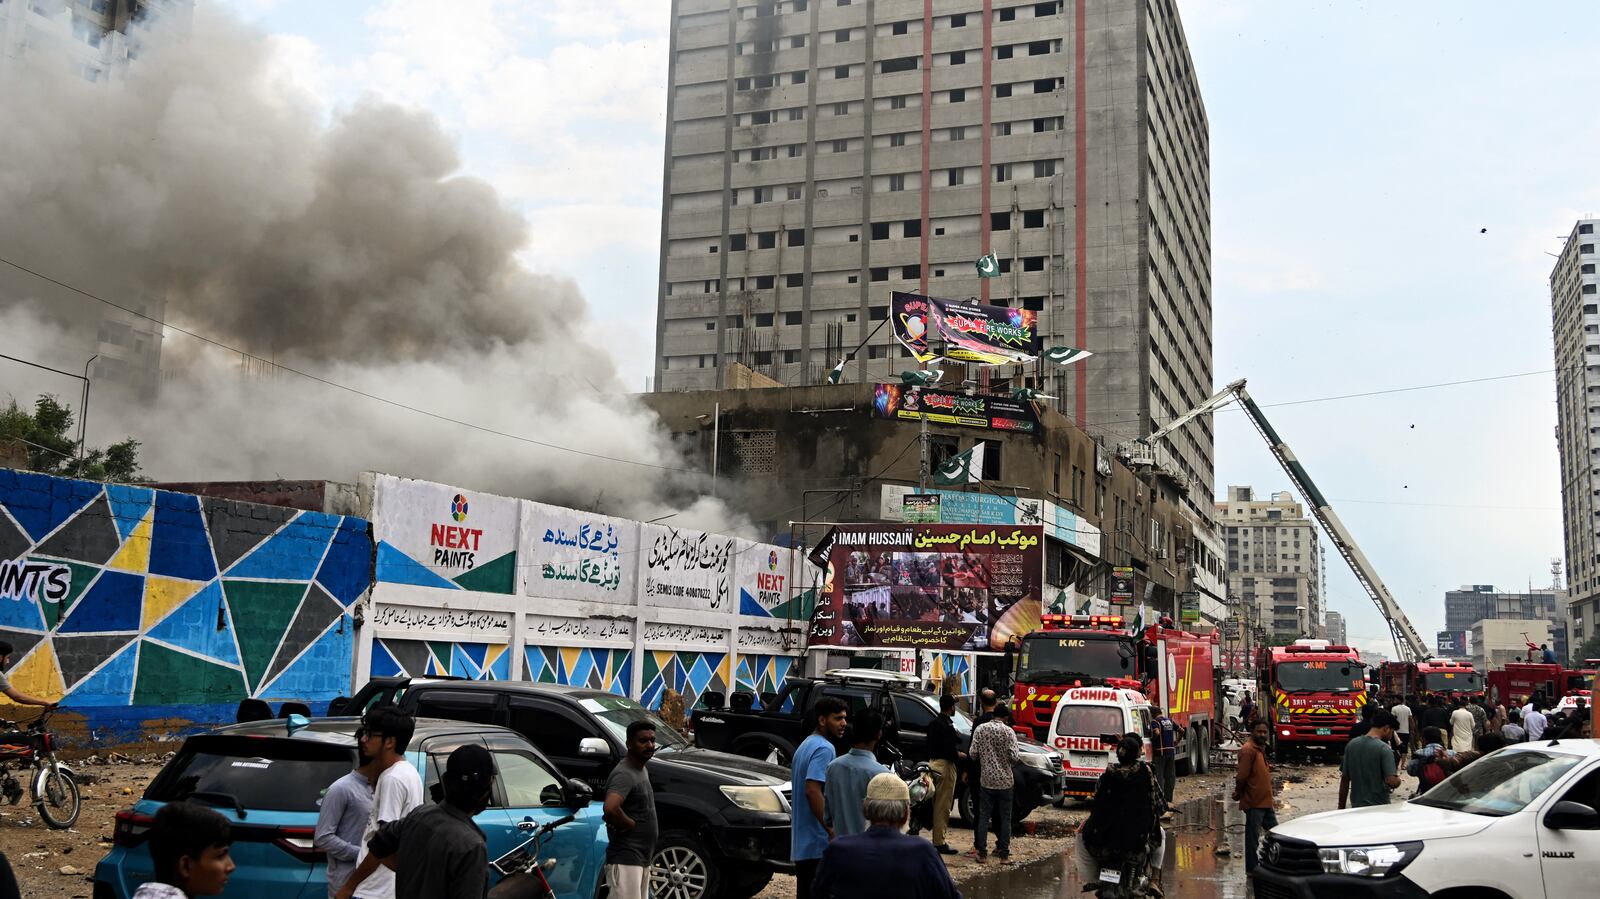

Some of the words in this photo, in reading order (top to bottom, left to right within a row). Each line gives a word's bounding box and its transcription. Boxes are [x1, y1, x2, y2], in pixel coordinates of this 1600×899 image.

[953, 319, 976, 329] SUPER
[980, 324, 995, 334] FIRE
[996, 326, 1022, 337] WORKS
[430, 523, 482, 551] NEXT
[543, 529, 577, 546] سندھ
[579, 524, 590, 549] گا
[839, 532, 866, 545] IMAM
[869, 532, 913, 545] HUSSAIN
[960, 530, 996, 550] امام
[998, 530, 1038, 550] موکب
[434, 548, 475, 570] PAINTS
[543, 562, 577, 580] سندھ
[579, 559, 590, 582] گا
[757, 572, 785, 592] NEXT
[657, 584, 671, 595] SEMIS
[673, 586, 684, 596] CODE
[759, 590, 781, 605] PAINTS
[427, 616, 436, 630] ہے
[864, 625, 876, 634] نماز
[941, 627, 967, 636] خواتین
[882, 636, 891, 644] ہے
[890, 635, 912, 643] انتظام
[912, 636, 940, 645] خصوصی
[1070, 689, 1118, 702] CHHIPA
[1054, 736, 1117, 750] CHHI
[1541, 850, 1575, 859] HILUX
